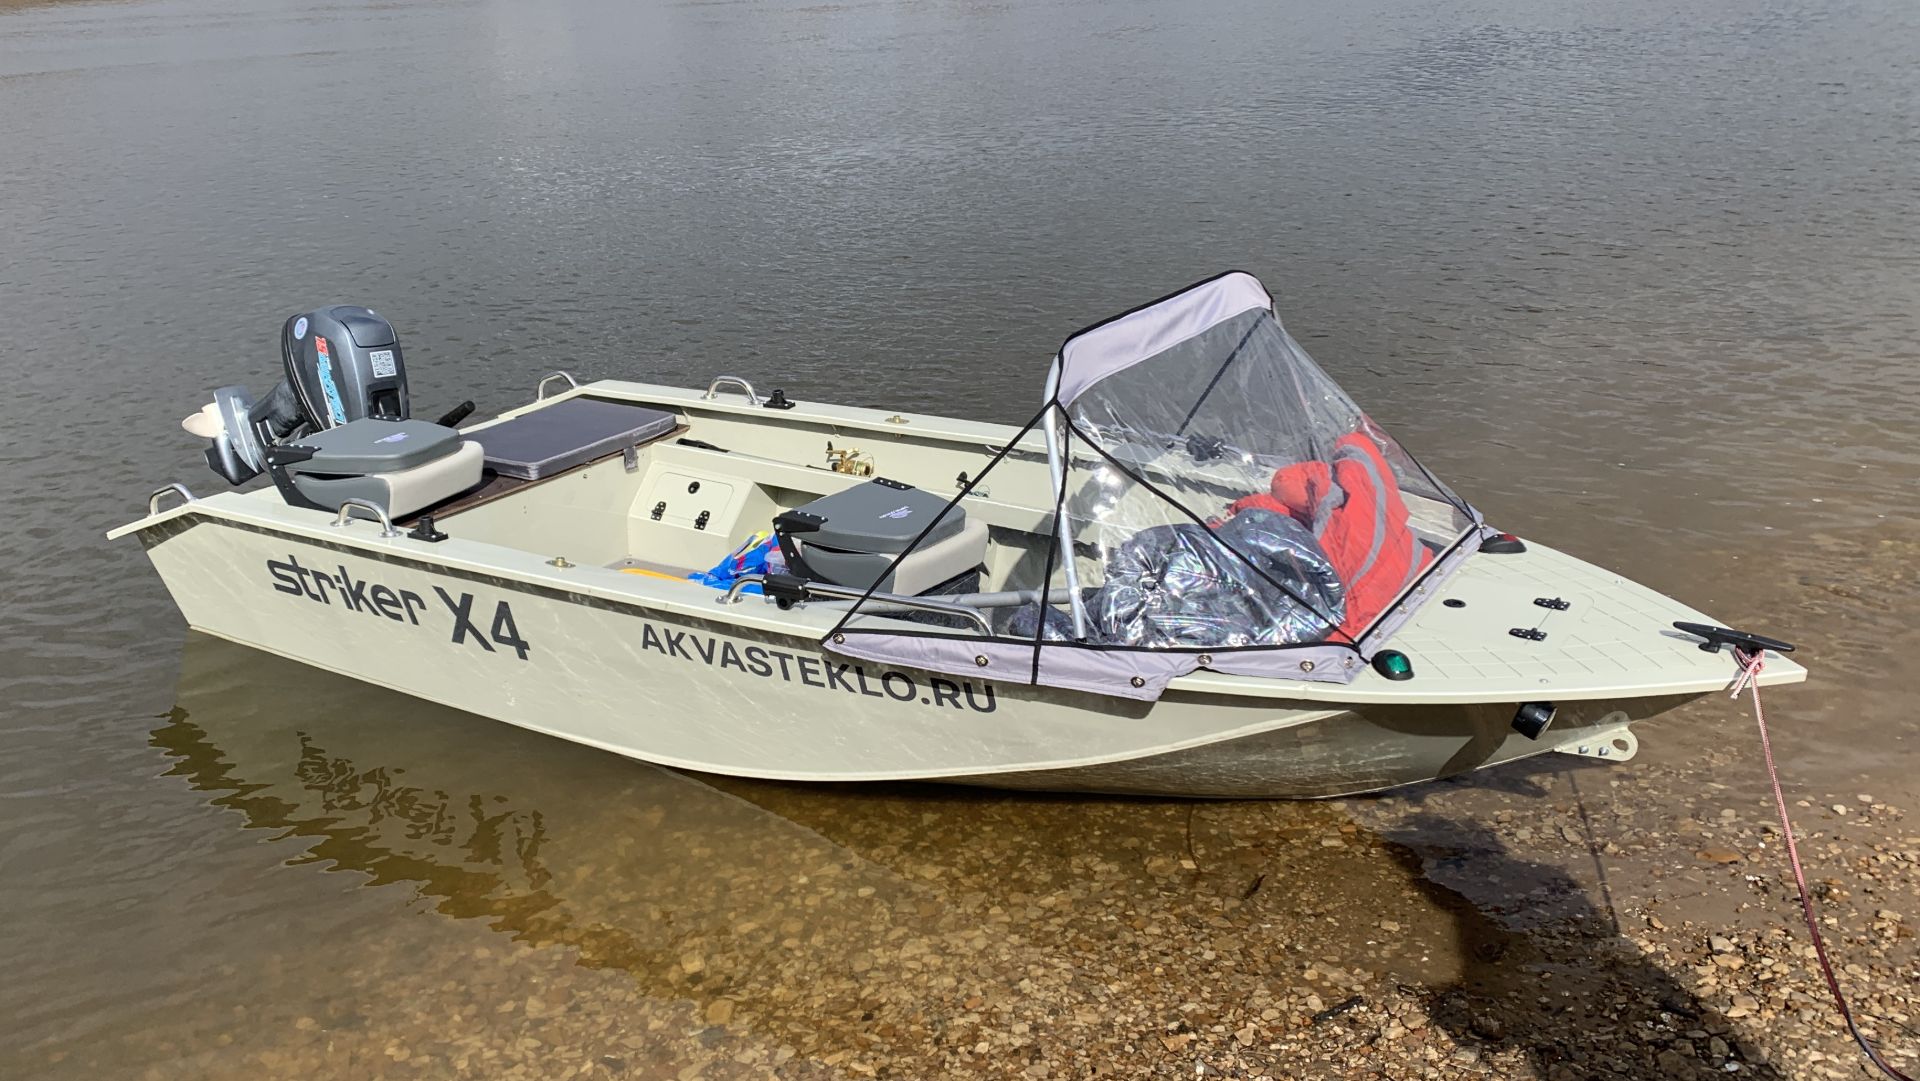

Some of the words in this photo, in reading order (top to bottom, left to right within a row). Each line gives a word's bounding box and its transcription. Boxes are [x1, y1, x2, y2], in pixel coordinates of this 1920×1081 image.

[267, 554, 427, 626] striker
[432, 585, 530, 661] X4
[641, 623, 997, 713] AKVASTEKLO.RU
